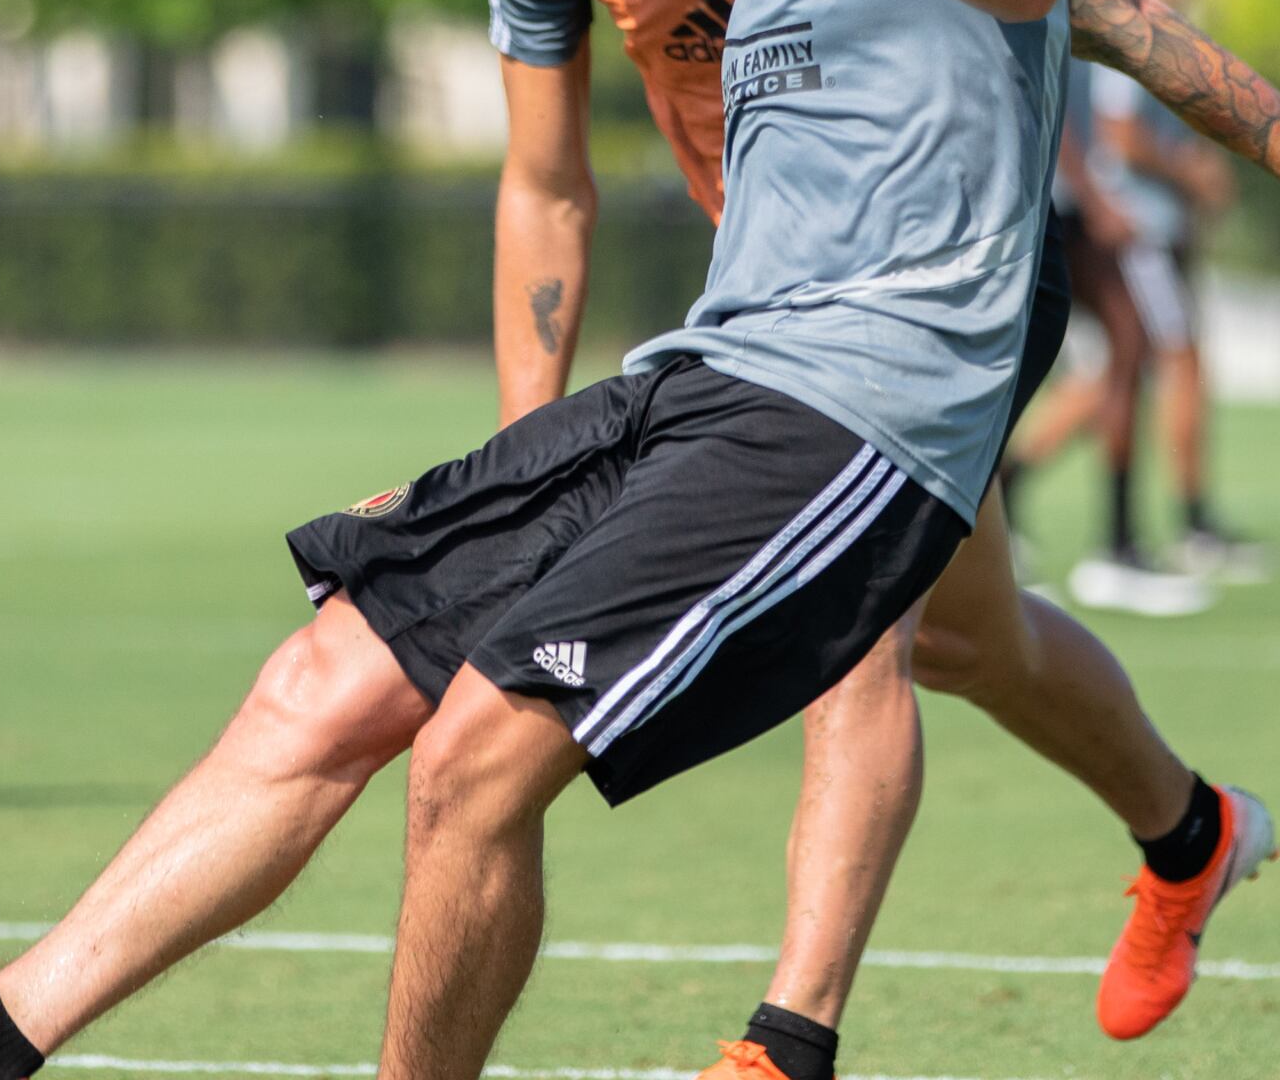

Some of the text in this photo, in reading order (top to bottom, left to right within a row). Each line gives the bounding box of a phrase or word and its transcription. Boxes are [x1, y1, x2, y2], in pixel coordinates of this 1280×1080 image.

[664, 38, 723, 63] adi
[743, 39, 814, 77] FAMILY
[532, 646, 586, 687] adidas
